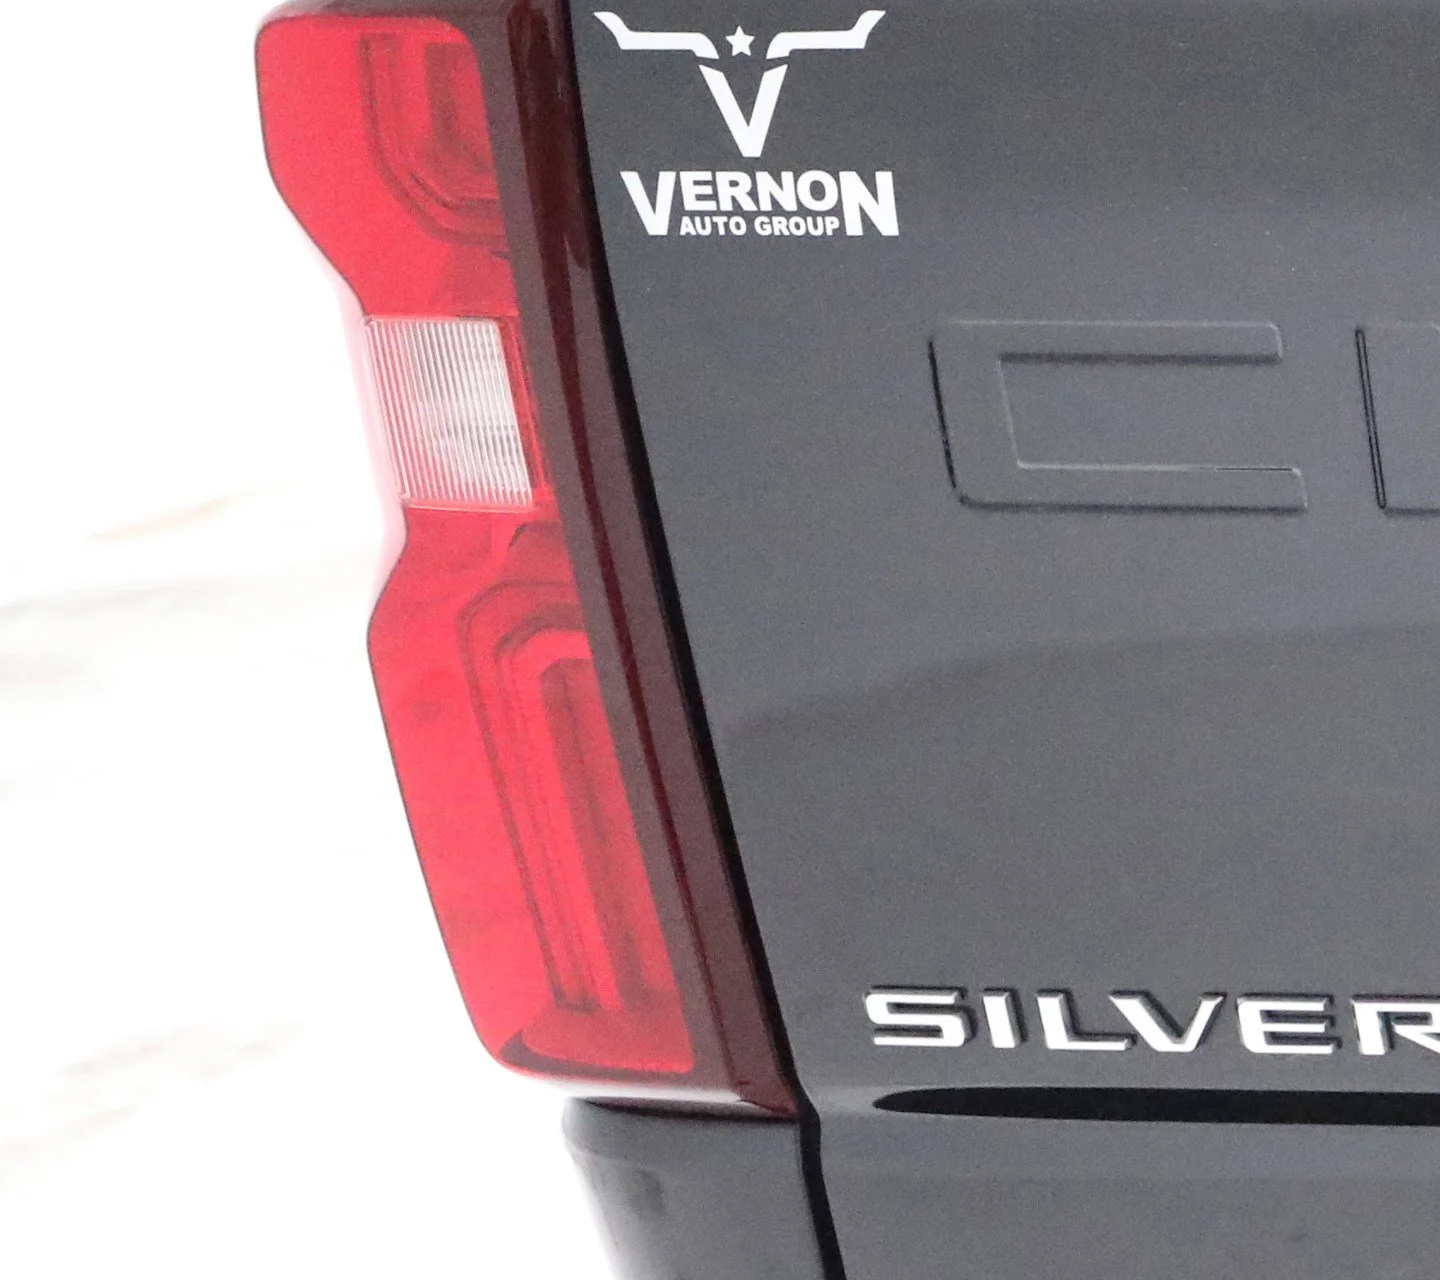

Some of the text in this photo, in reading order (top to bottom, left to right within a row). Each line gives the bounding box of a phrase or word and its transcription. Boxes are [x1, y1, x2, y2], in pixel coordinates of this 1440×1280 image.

[619, 169, 900, 237] VERNON
[678, 215, 840, 237] AUTO GROUP
